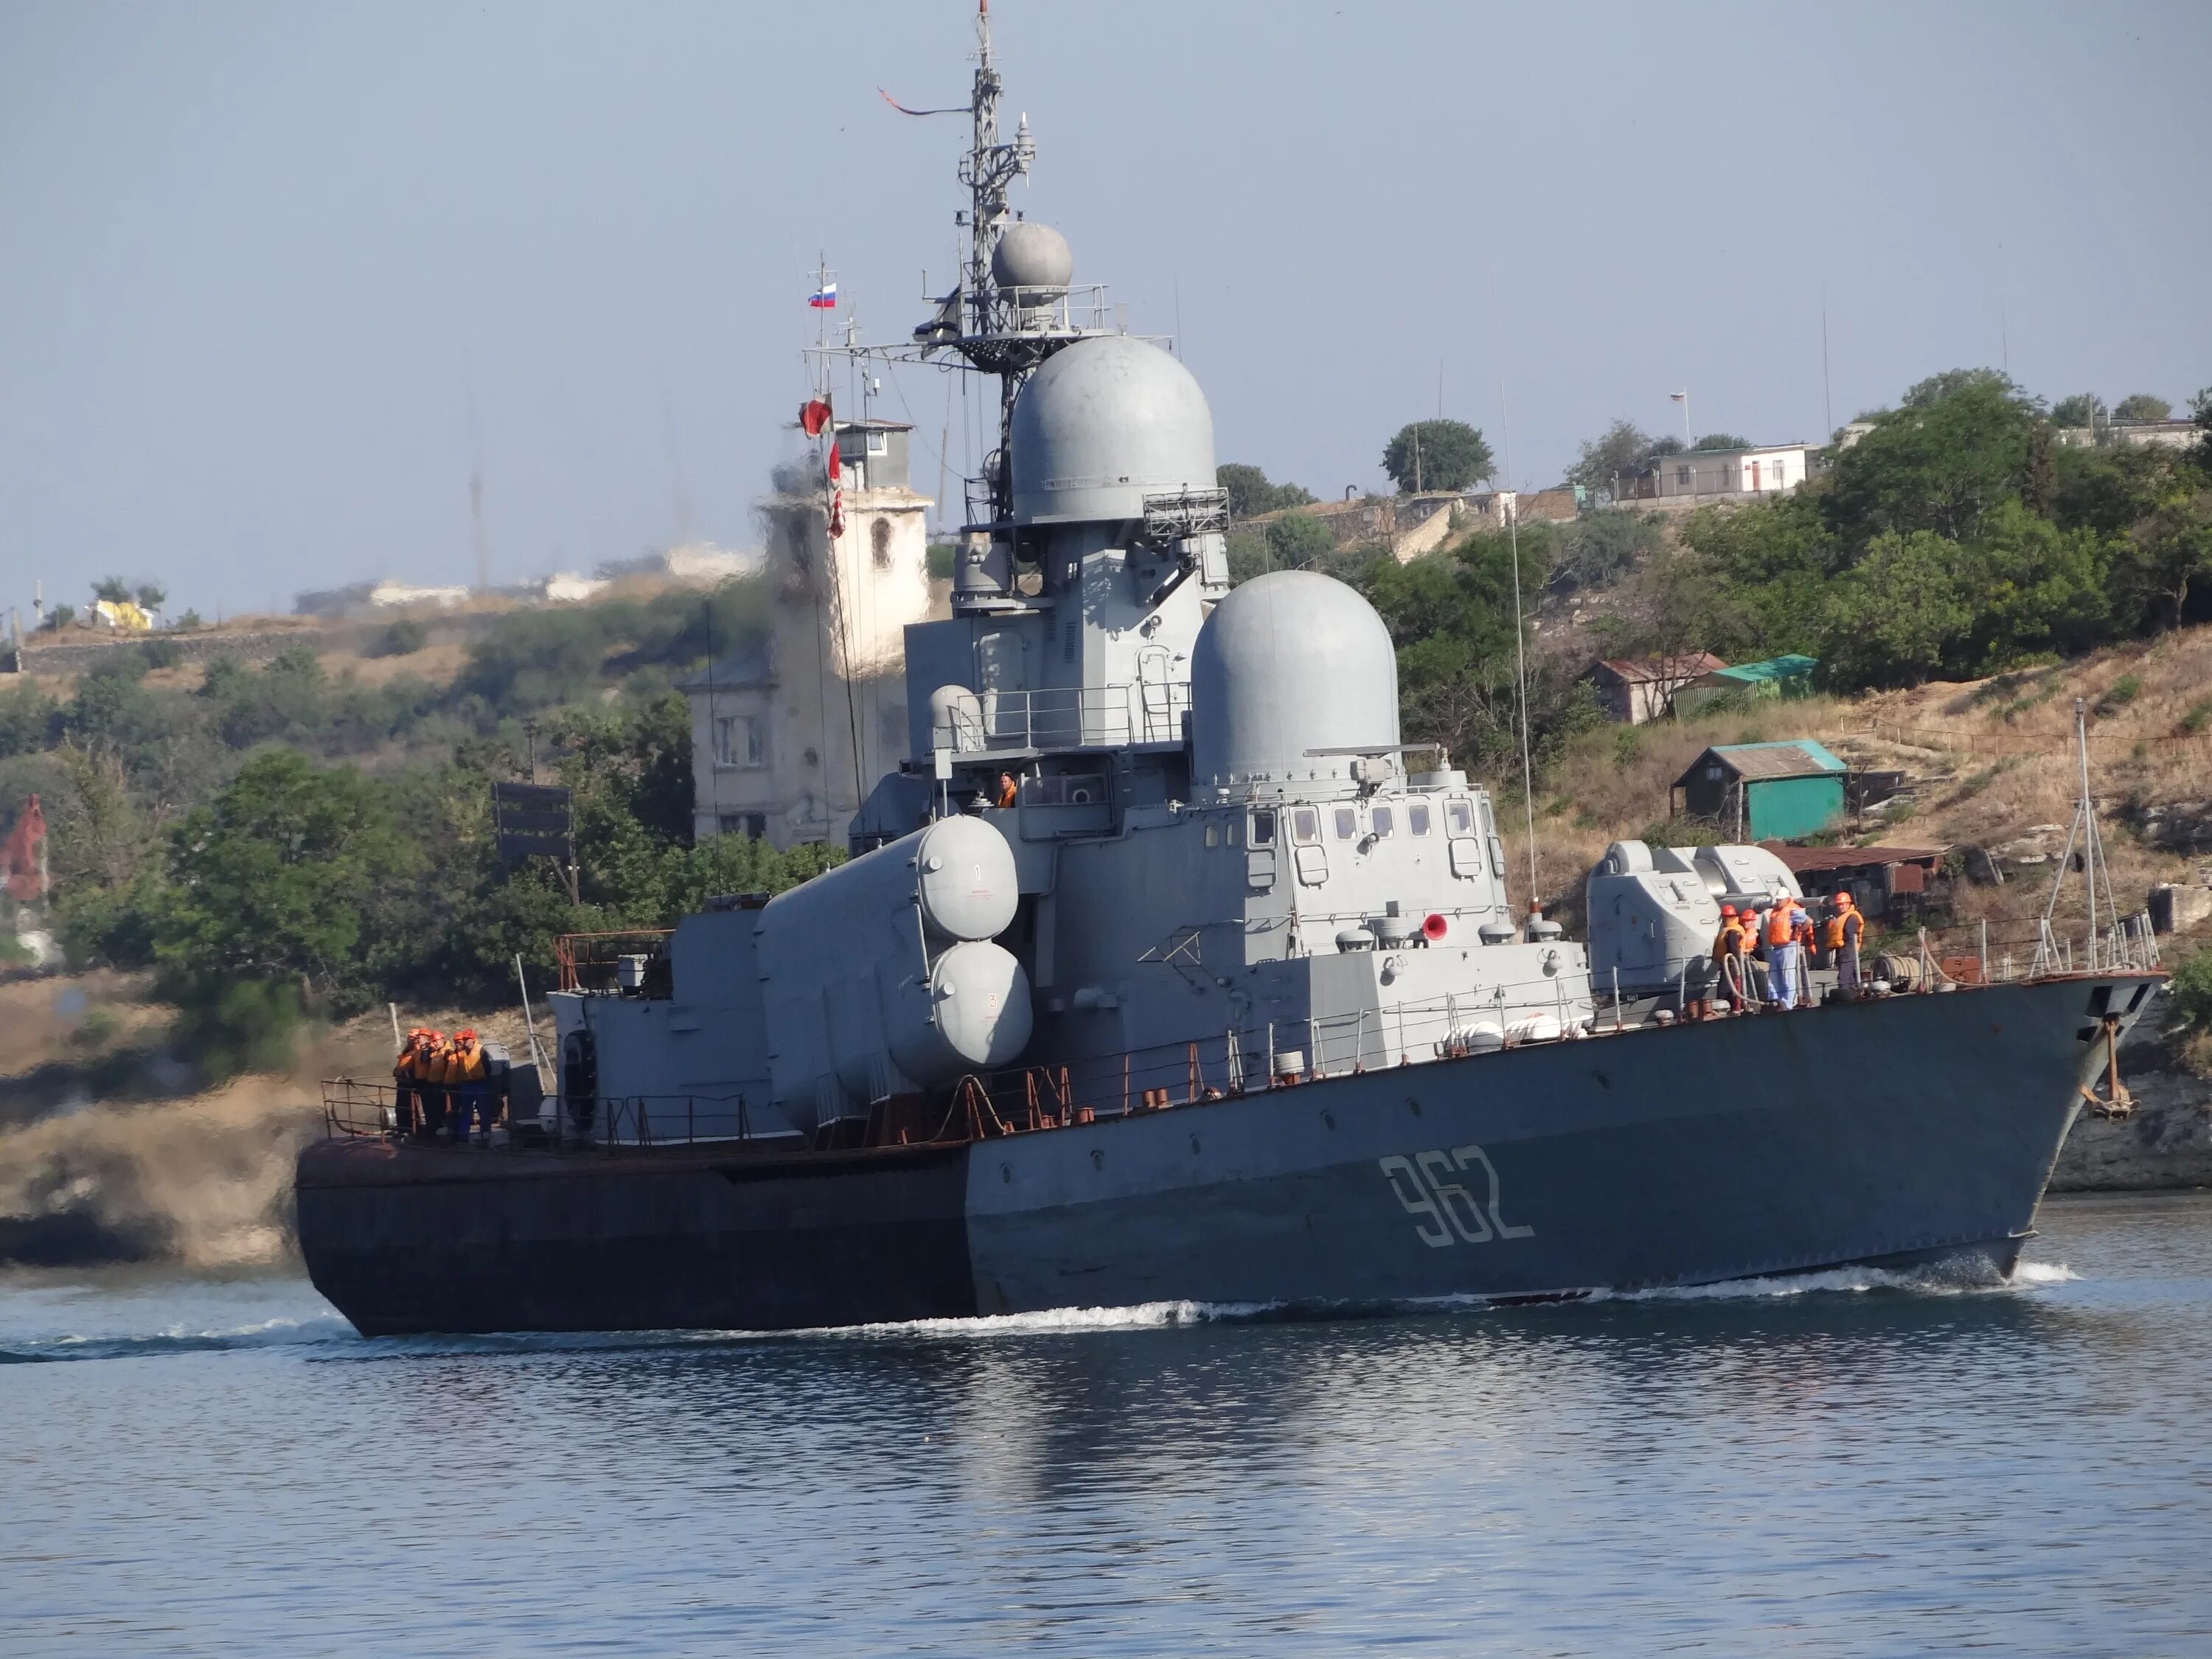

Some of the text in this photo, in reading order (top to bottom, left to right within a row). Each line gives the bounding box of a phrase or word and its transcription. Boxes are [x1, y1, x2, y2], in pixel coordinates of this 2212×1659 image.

[974, 864, 981, 880] 1
[988, 993, 998, 1008] 3
[1379, 1144, 1535, 1248] 962
